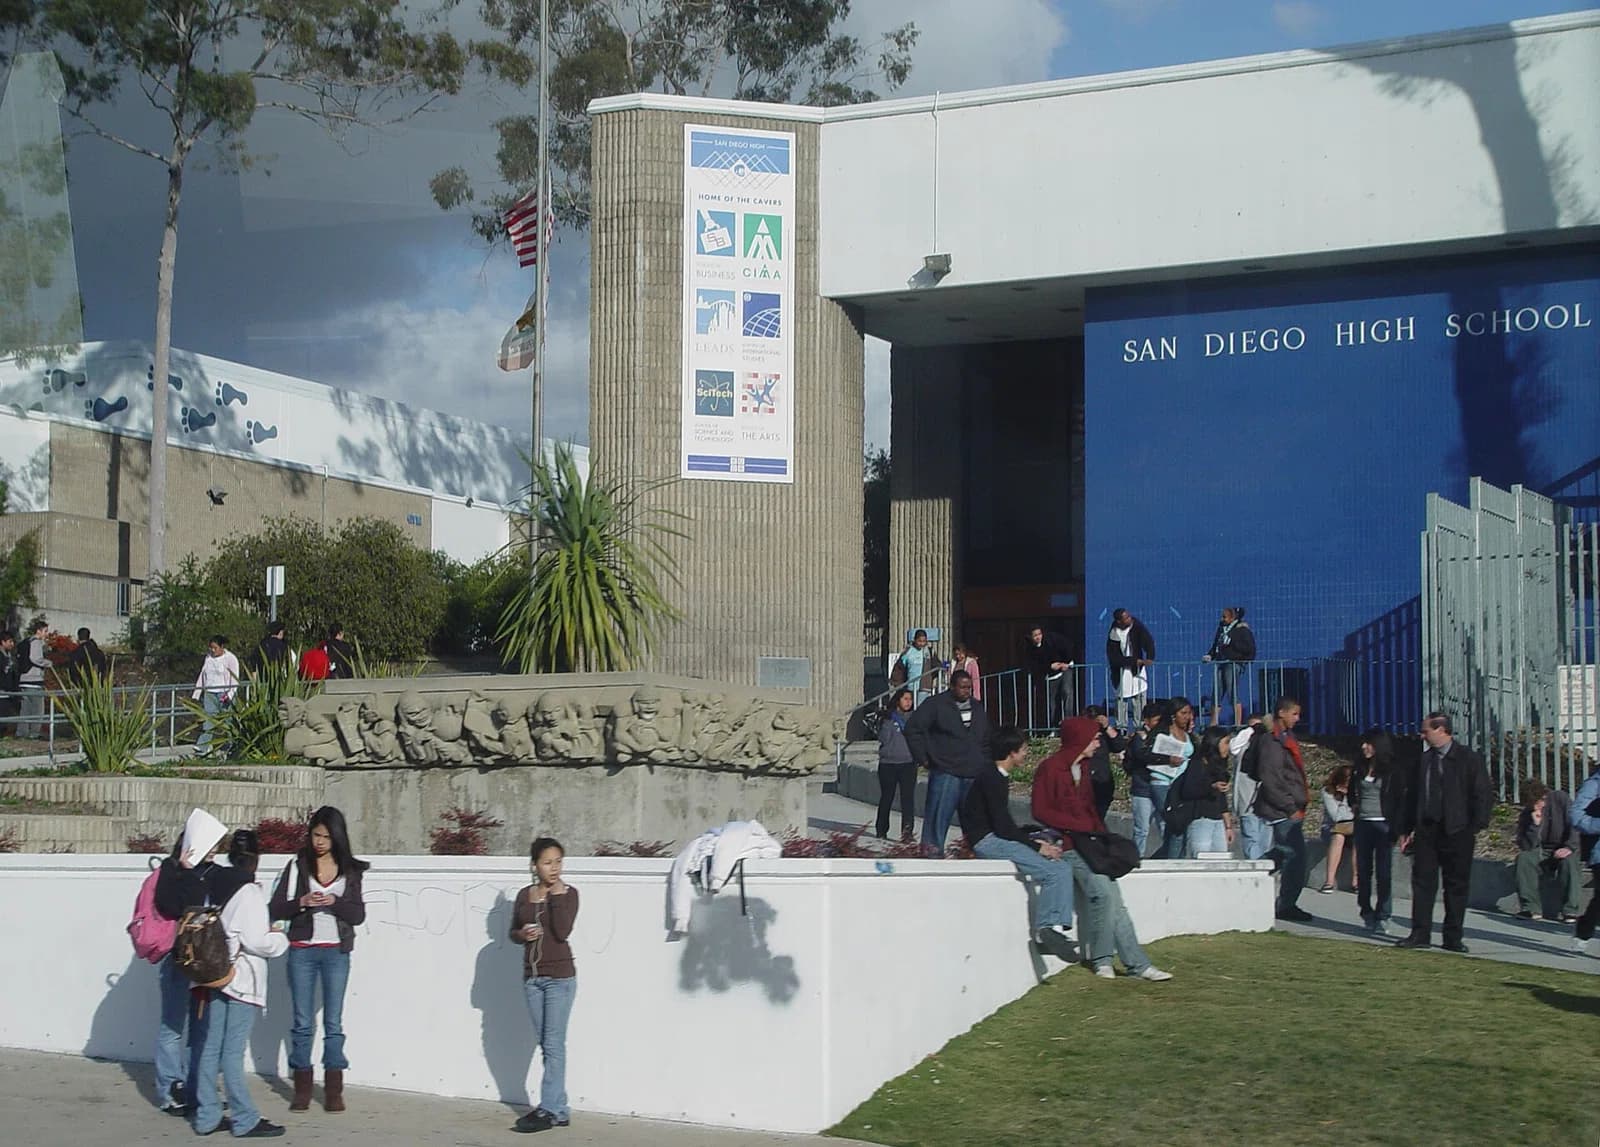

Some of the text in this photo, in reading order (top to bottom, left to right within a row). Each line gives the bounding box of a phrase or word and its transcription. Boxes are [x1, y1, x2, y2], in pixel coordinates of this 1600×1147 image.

[729, 140, 748, 149] DIEGO
[698, 193, 783, 206] HOME OF THE CAVERS
[1123, 302, 1592, 363] SAN DIEGO HIGH SCHOOL
[695, 343, 736, 353] LEADS
[696, 387, 733, 399] SciTech
[742, 432, 781, 442] THE ARTS
